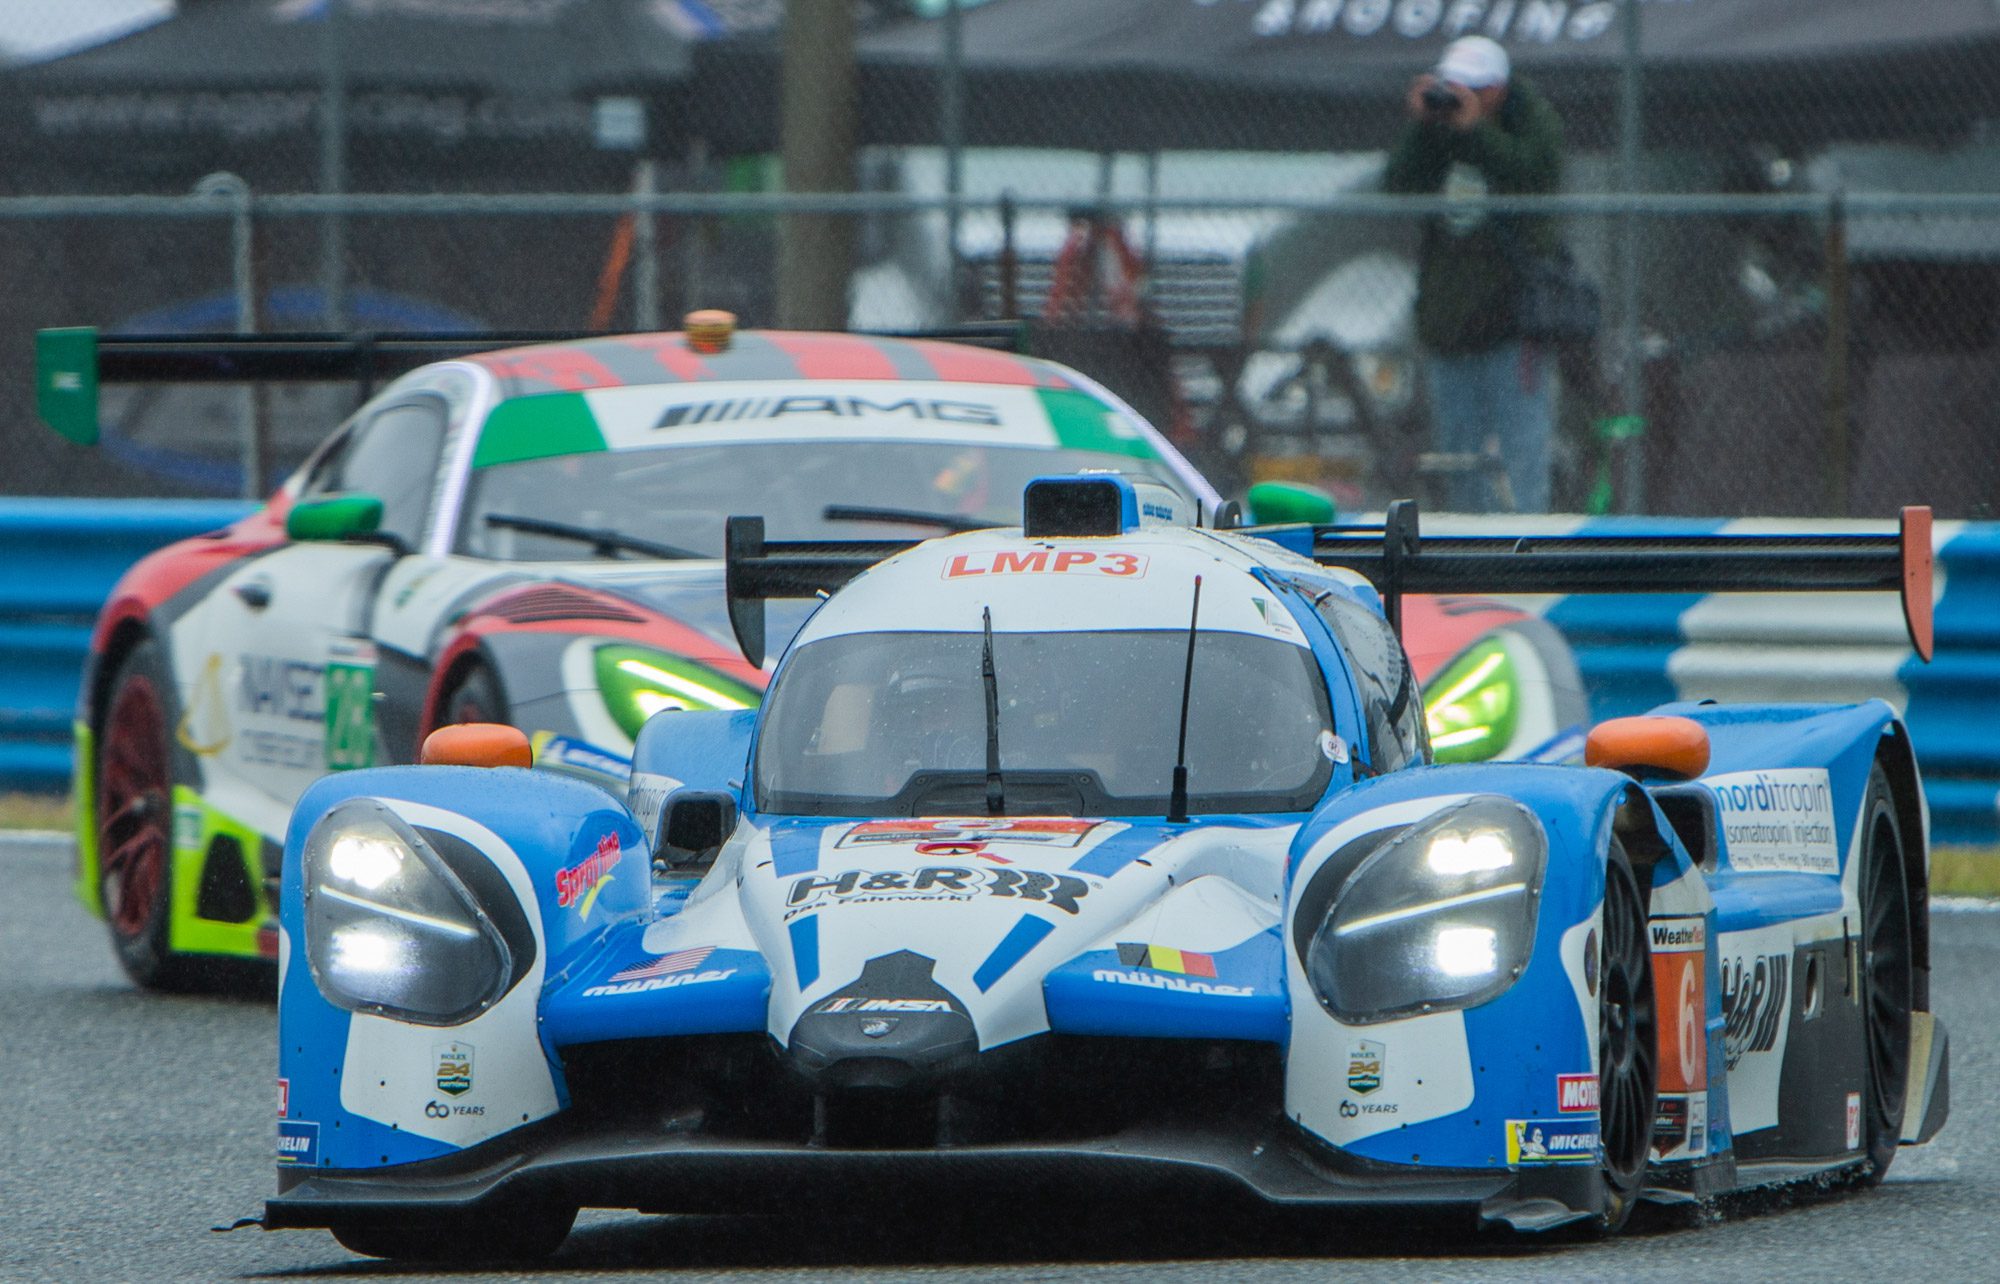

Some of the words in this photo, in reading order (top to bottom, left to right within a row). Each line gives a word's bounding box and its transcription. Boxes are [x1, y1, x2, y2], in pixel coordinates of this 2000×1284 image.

[773, 394, 1003, 426] AMG
[948, 550, 1139, 578] LMP3
[788, 866, 975, 905] H&R
[784, 901, 828, 922] Das
[857, 998, 953, 1013] IMSA
[1679, 959, 1697, 1086] 6
[1350, 1051, 1377, 1060] ROLEX
[437, 1062, 470, 1077] 24
[1348, 1061, 1380, 1075] 24
[425, 1100, 450, 1119] 60
[453, 1106, 486, 1117] YEARS
[1340, 1100, 1359, 1118] 60
[1361, 1104, 1399, 1114] YEARS
